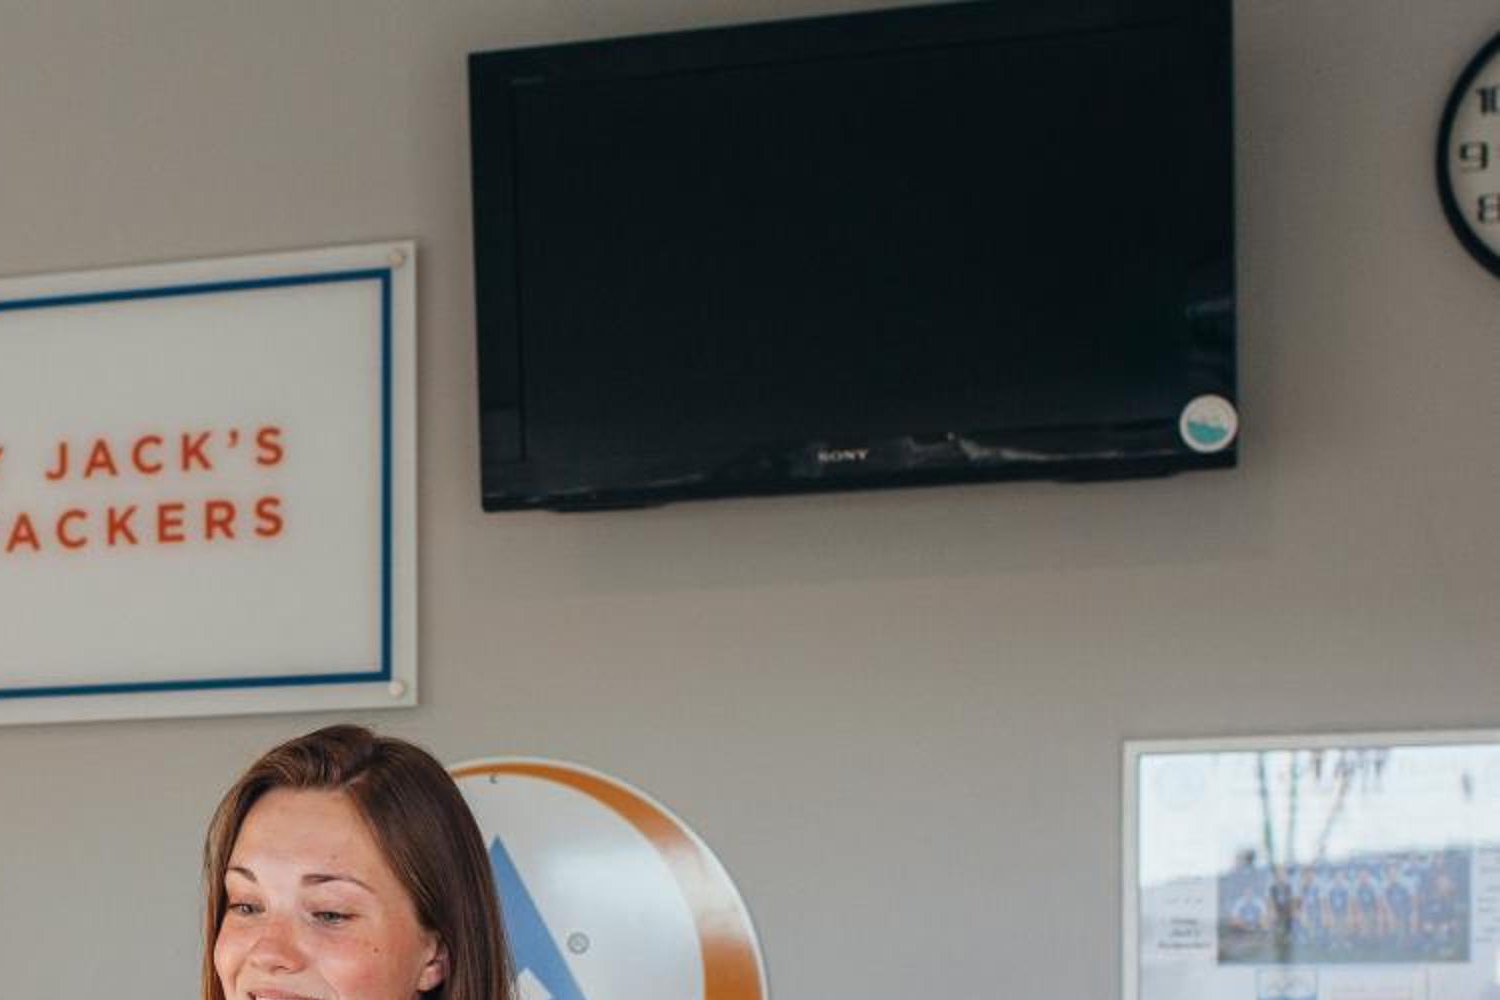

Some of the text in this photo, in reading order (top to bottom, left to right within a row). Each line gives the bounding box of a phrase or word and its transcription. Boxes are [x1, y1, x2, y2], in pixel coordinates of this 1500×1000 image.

[1459, 141, 1488, 172] 9
[46, 427, 284, 482] JACK'S
[817, 448, 869, 462] SONY
